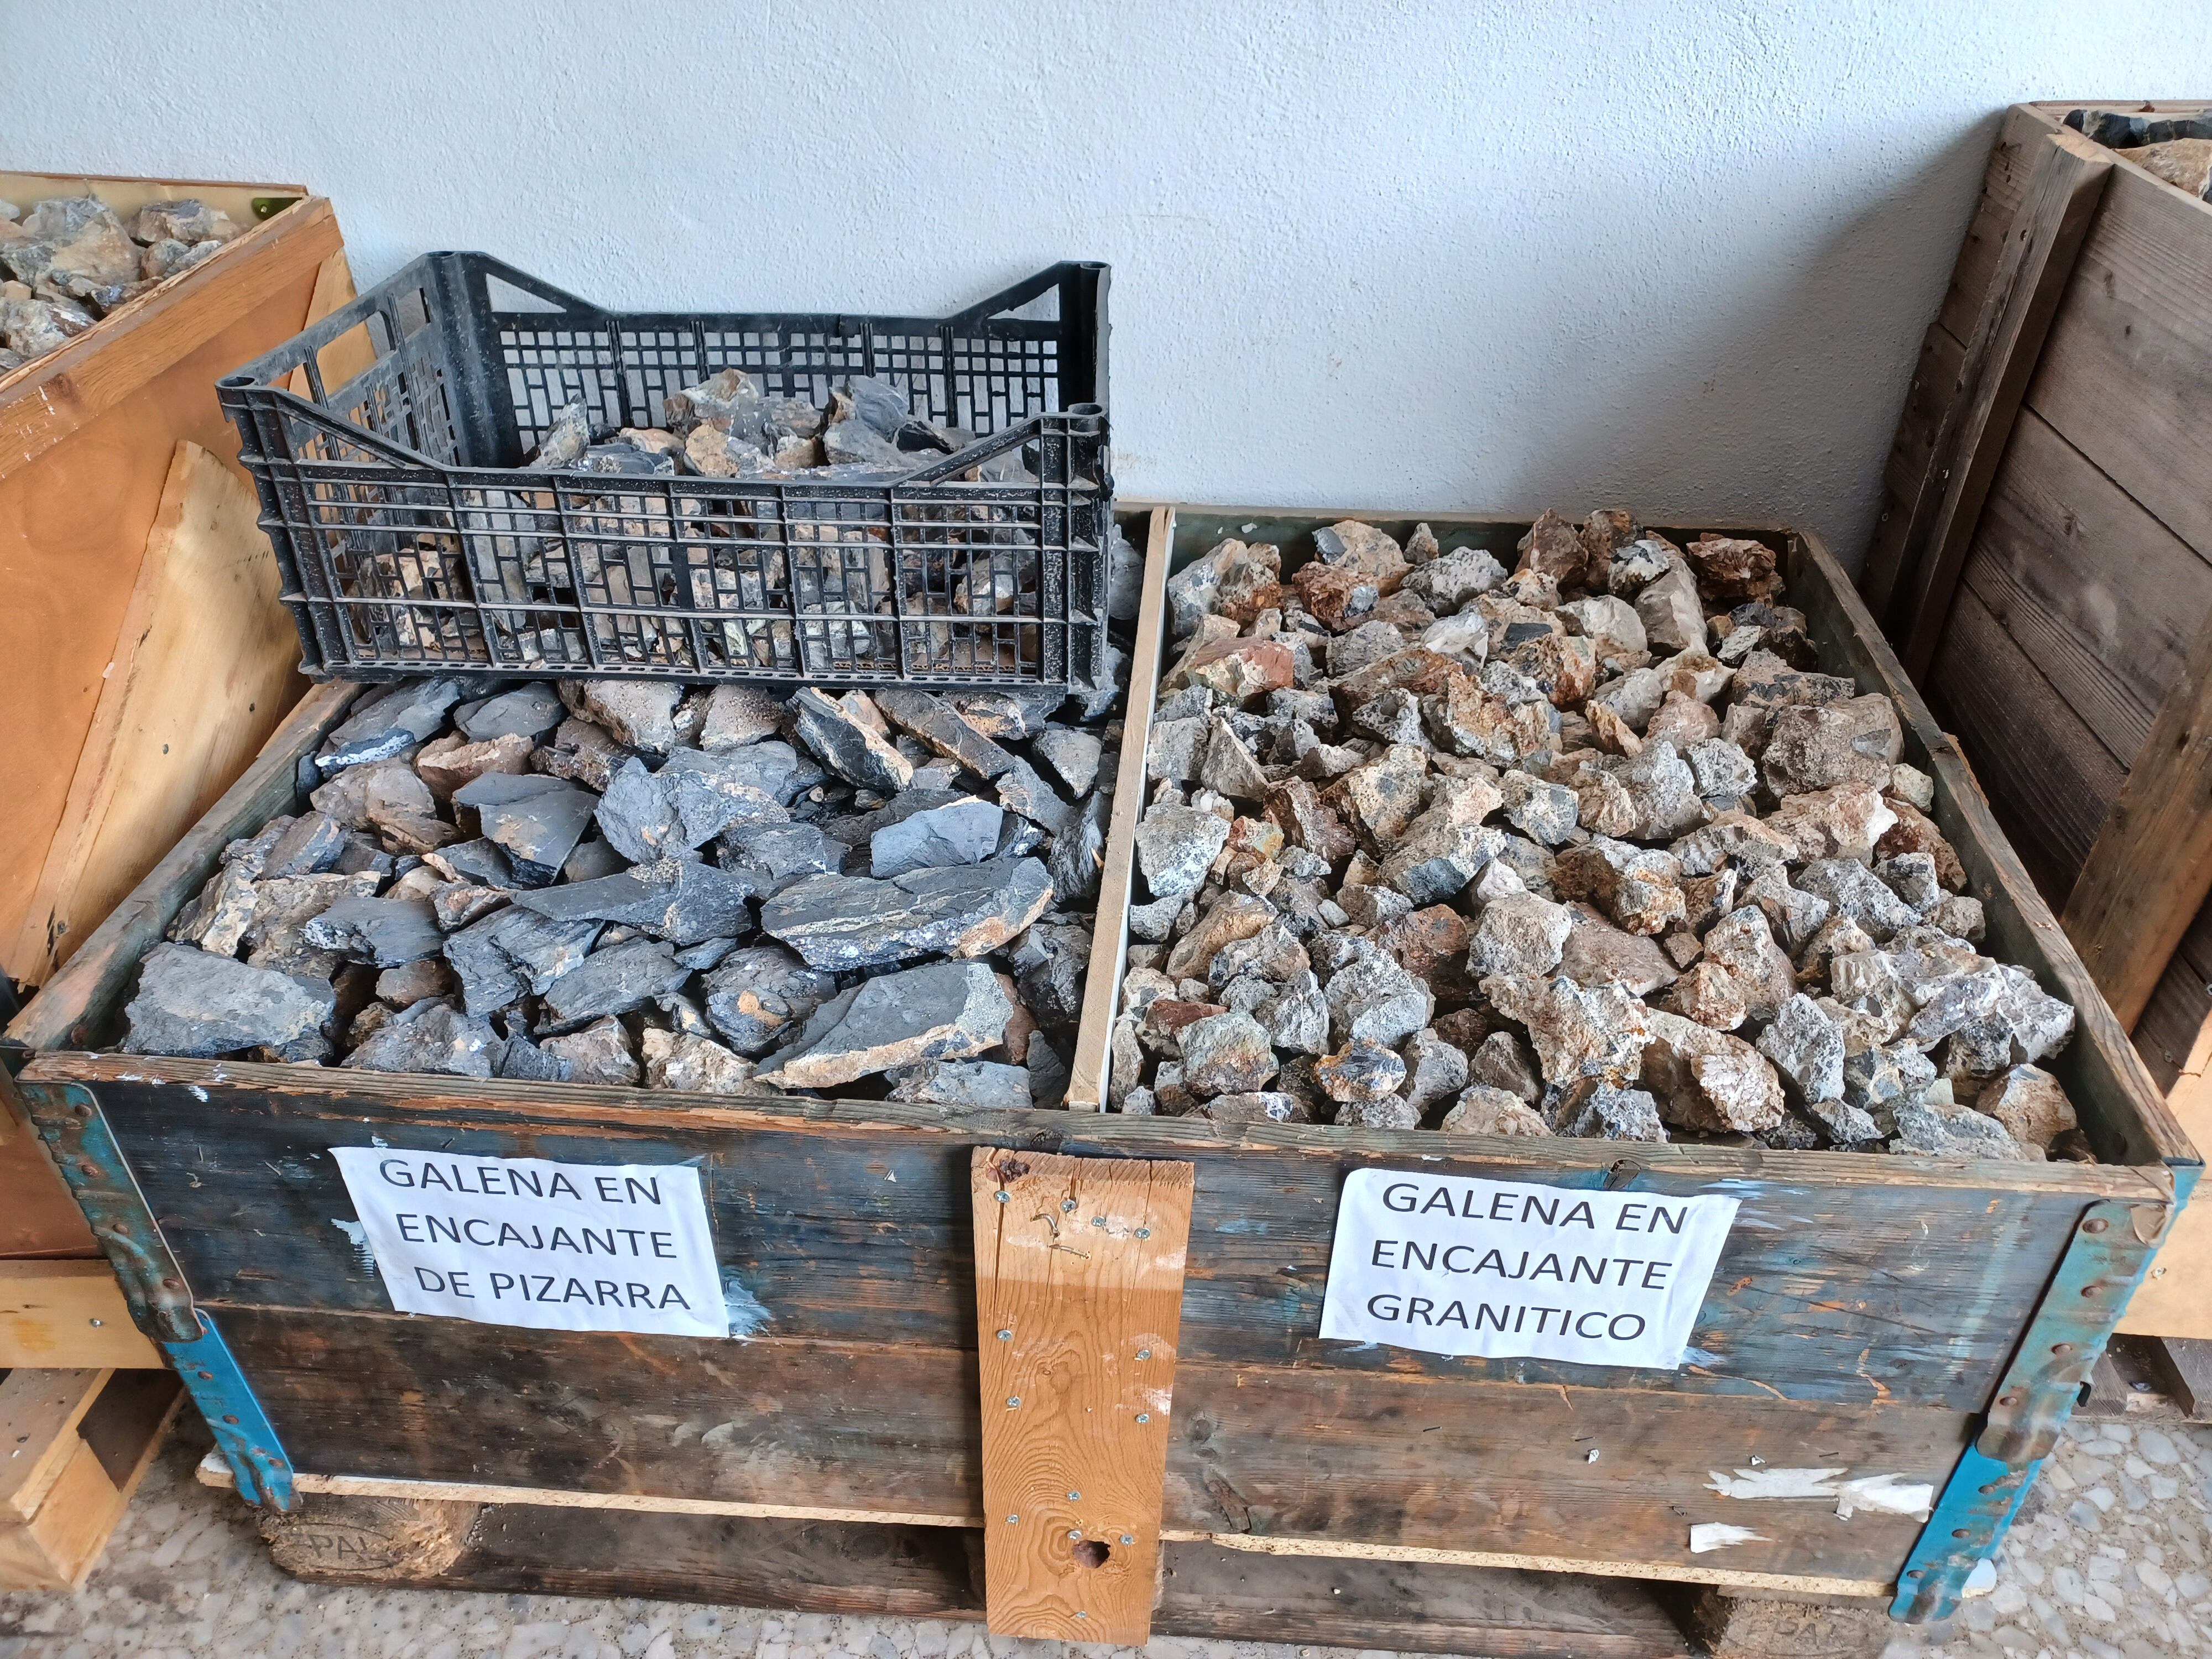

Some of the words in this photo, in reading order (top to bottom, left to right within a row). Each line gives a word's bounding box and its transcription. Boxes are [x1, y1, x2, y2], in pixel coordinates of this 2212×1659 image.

[379, 1159, 582, 1201] GALENA
[594, 1177, 661, 1205] EN
[1383, 1183, 1595, 1229] GALENA
[1615, 1203, 1688, 1234] EN
[396, 1213, 677, 1259] ENCAJANTE
[414, 1266, 475, 1298] DE
[489, 1272, 691, 1310] PIZARRA
[1371, 1240, 1672, 1290] ENCAJANTE
[1367, 1294, 1645, 1340] GRANITICO
